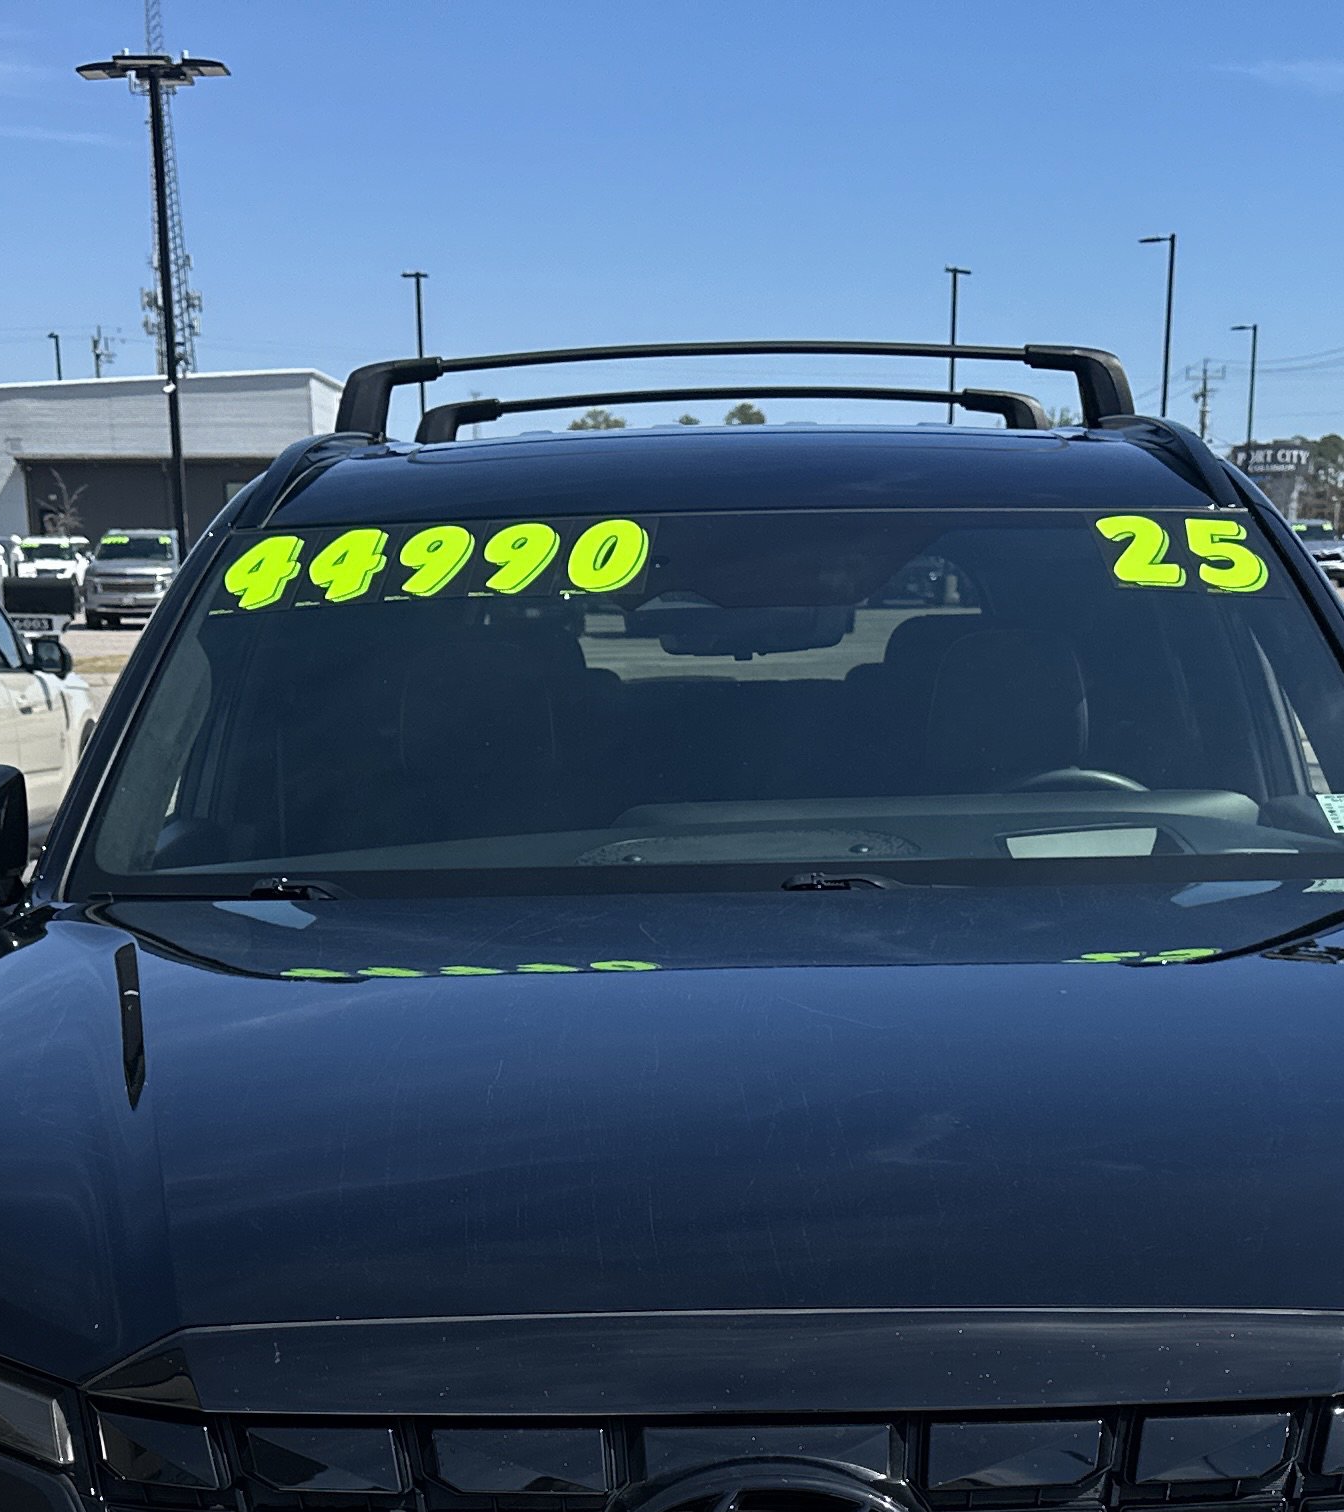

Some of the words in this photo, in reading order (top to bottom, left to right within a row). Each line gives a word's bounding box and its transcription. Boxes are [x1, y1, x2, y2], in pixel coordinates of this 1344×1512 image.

[1277, 449, 1309, 465] CITY
[224, 519, 650, 610] 44990
[1095, 515, 1269, 592] 25
